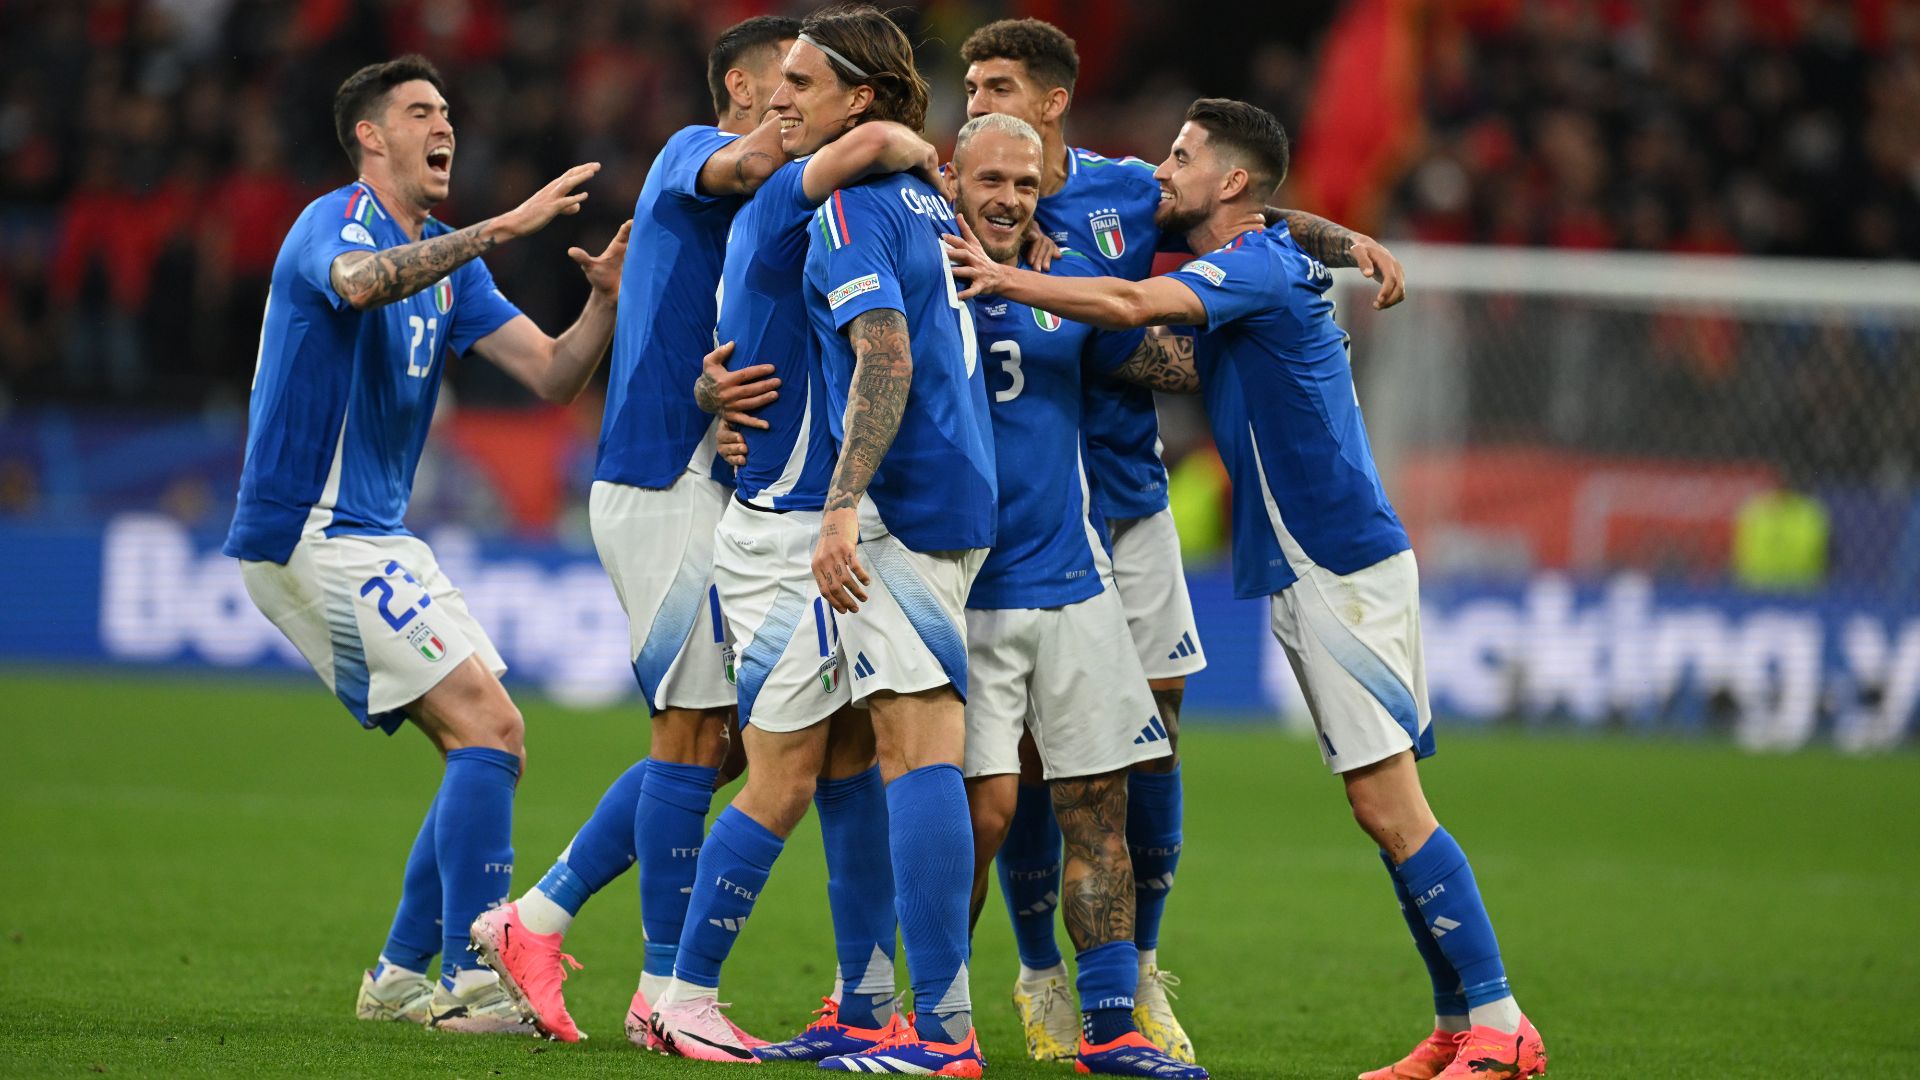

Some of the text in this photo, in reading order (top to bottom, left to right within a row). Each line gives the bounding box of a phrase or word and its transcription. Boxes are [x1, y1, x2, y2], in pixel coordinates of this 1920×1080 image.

[1093, 217, 1118, 230] ITALIA
[829, 278, 878, 305] FOUNDATION
[407, 315, 437, 378] 23
[990, 340, 1024, 403] 3
[413, 629, 431, 648] ITALIA
[725, 652, 737, 662] ITA
[820, 659, 838, 672] ITALIA
[671, 847, 701, 858] ITA
[484, 862, 513, 874] ITA
[1415, 883, 1445, 908] ALIA
[1099, 996, 1135, 1009] ITALI
